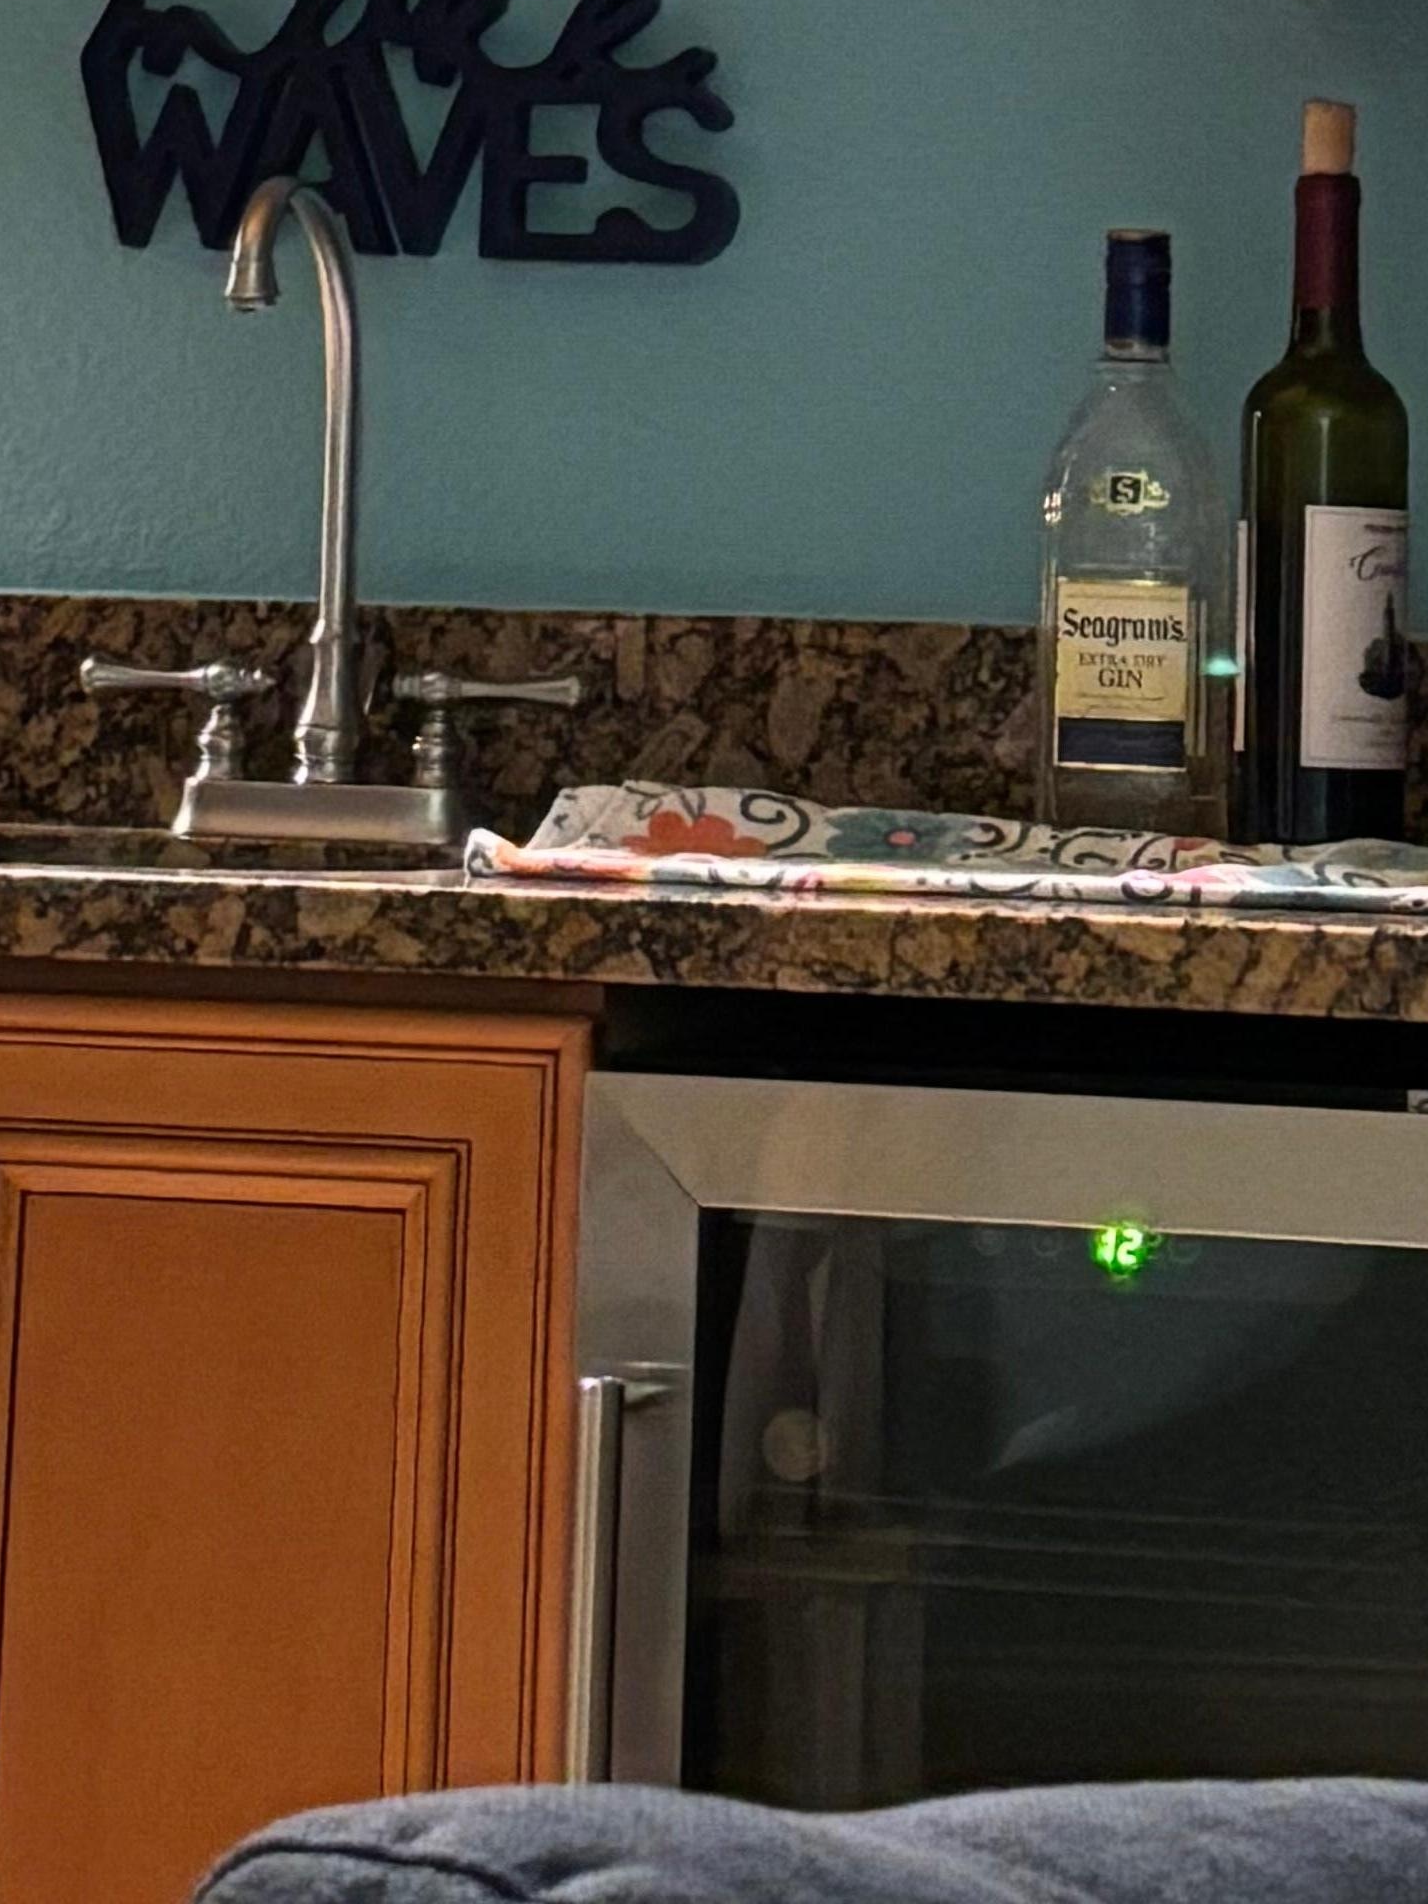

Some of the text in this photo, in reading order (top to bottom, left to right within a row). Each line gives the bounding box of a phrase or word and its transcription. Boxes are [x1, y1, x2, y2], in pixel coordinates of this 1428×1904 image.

[82, 54, 740, 264] WAVES
[1062, 607, 1187, 647] Seagram's
[1098, 667, 1143, 689] GIN
